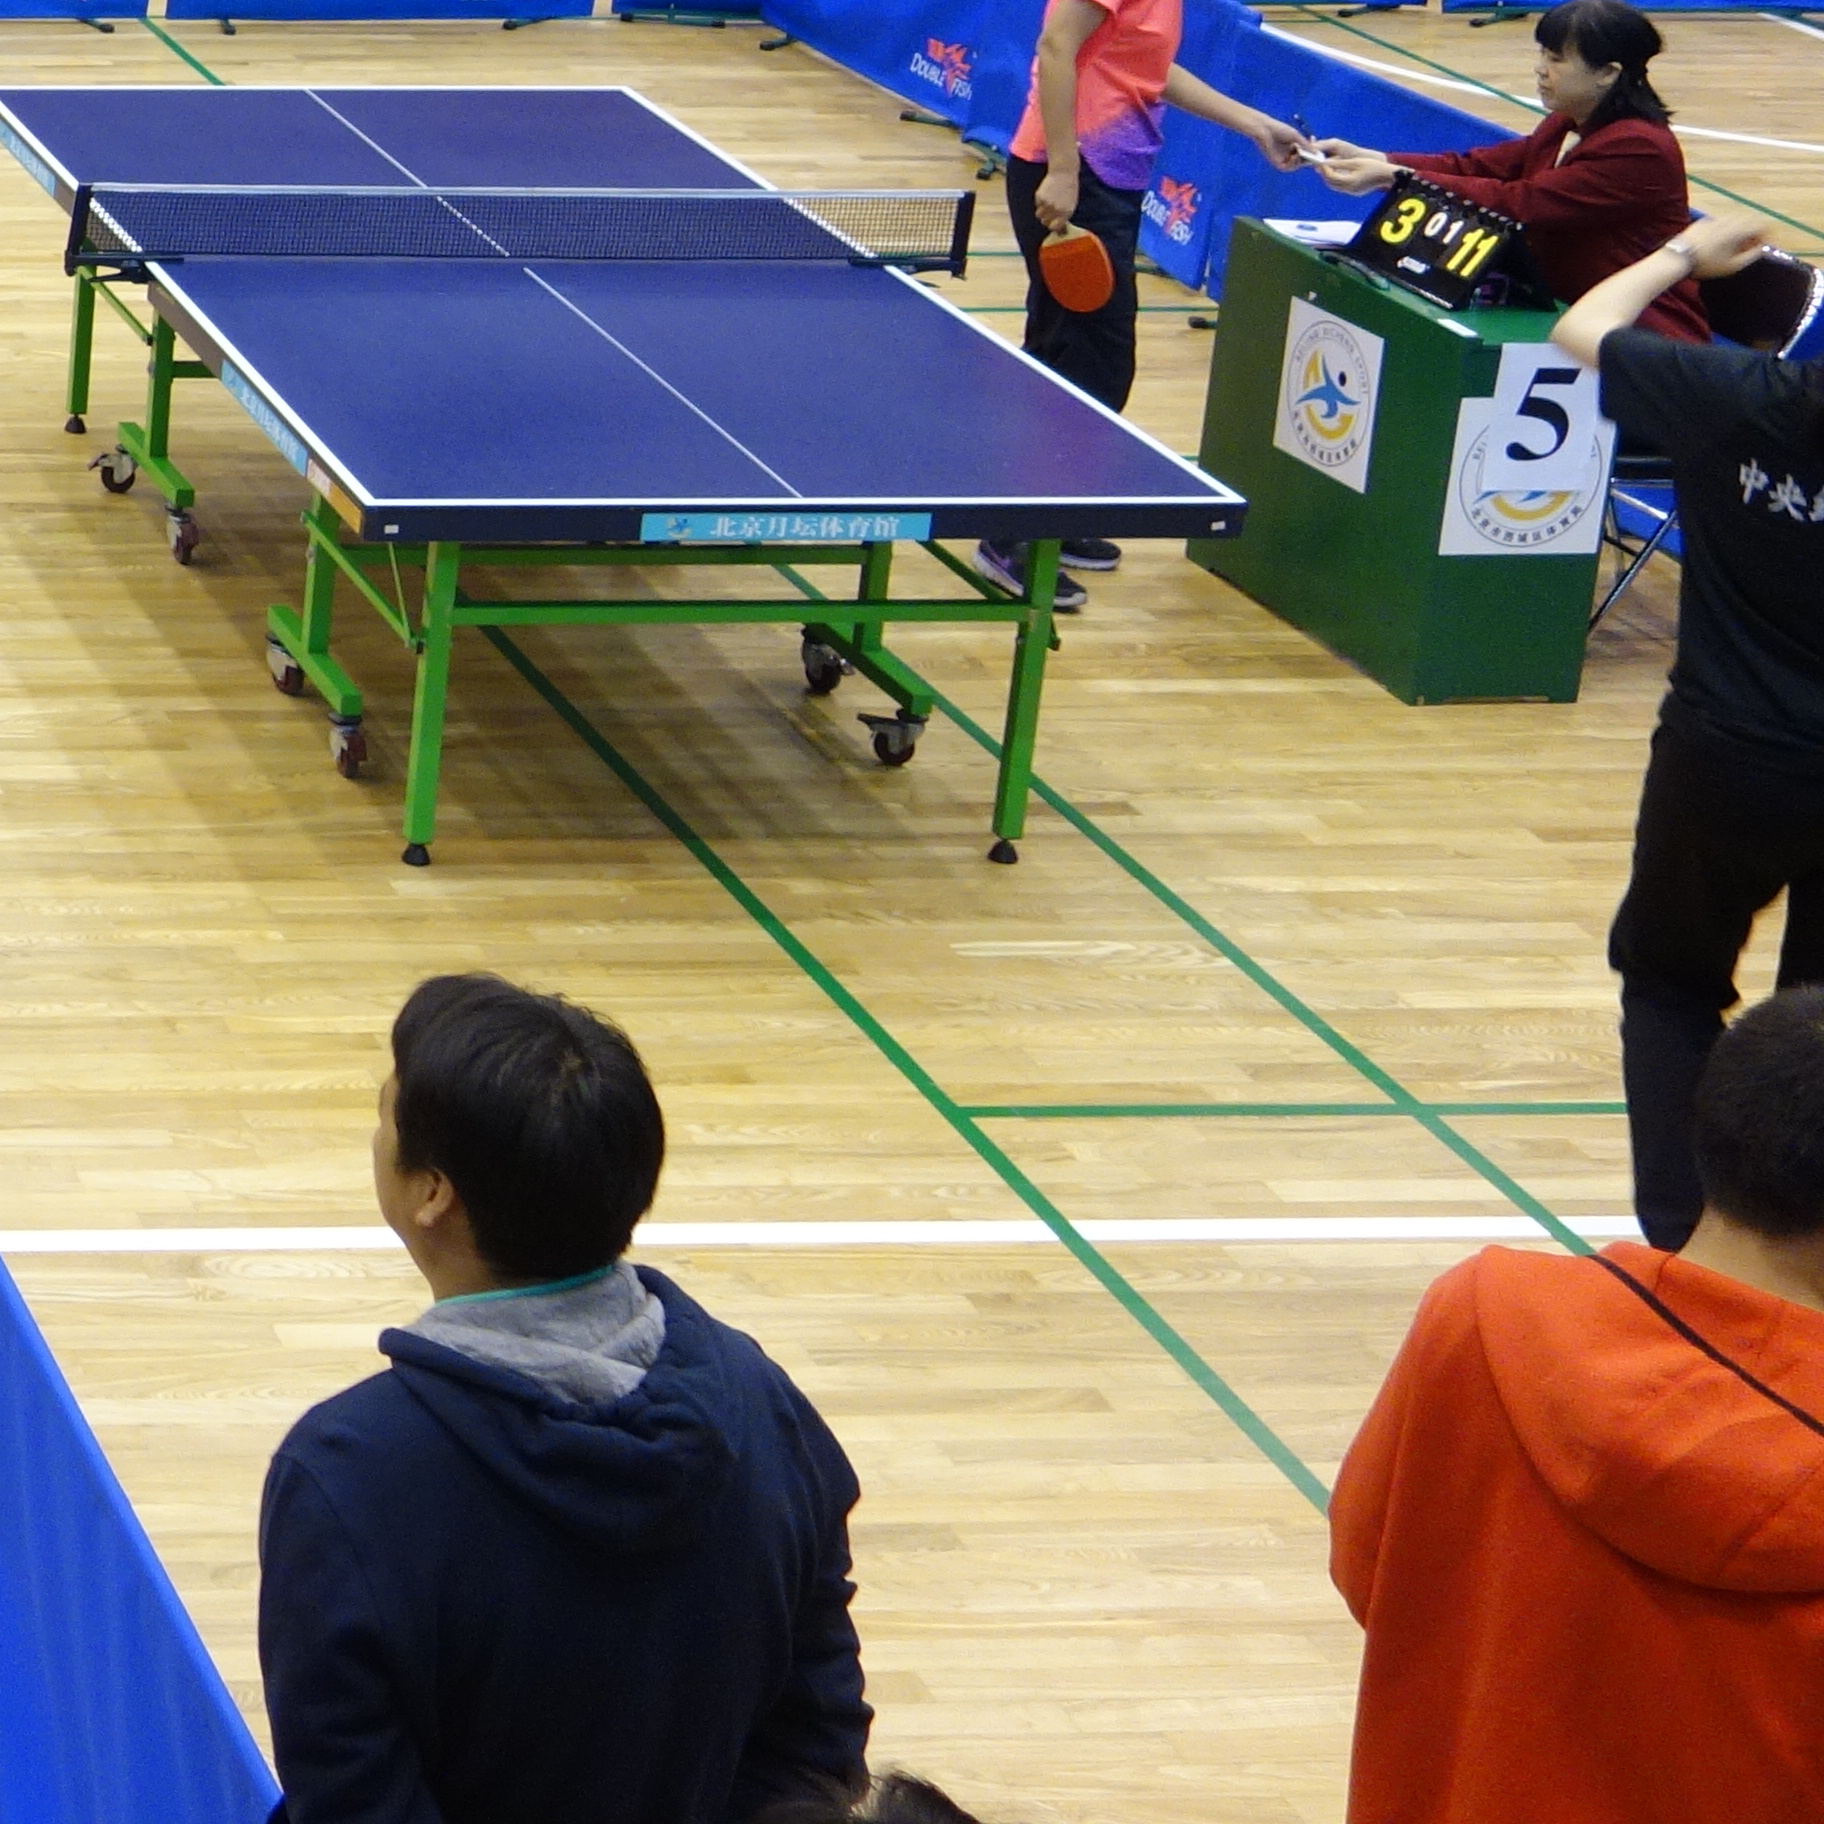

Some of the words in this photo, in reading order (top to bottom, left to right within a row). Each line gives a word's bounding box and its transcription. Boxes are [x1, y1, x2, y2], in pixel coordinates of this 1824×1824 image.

[1380, 198, 1427, 243] 3
[1446, 229, 1499, 277] 11
[1505, 367, 1583, 461] 5
[710, 516, 900, 539] 北京月坛体育馆
